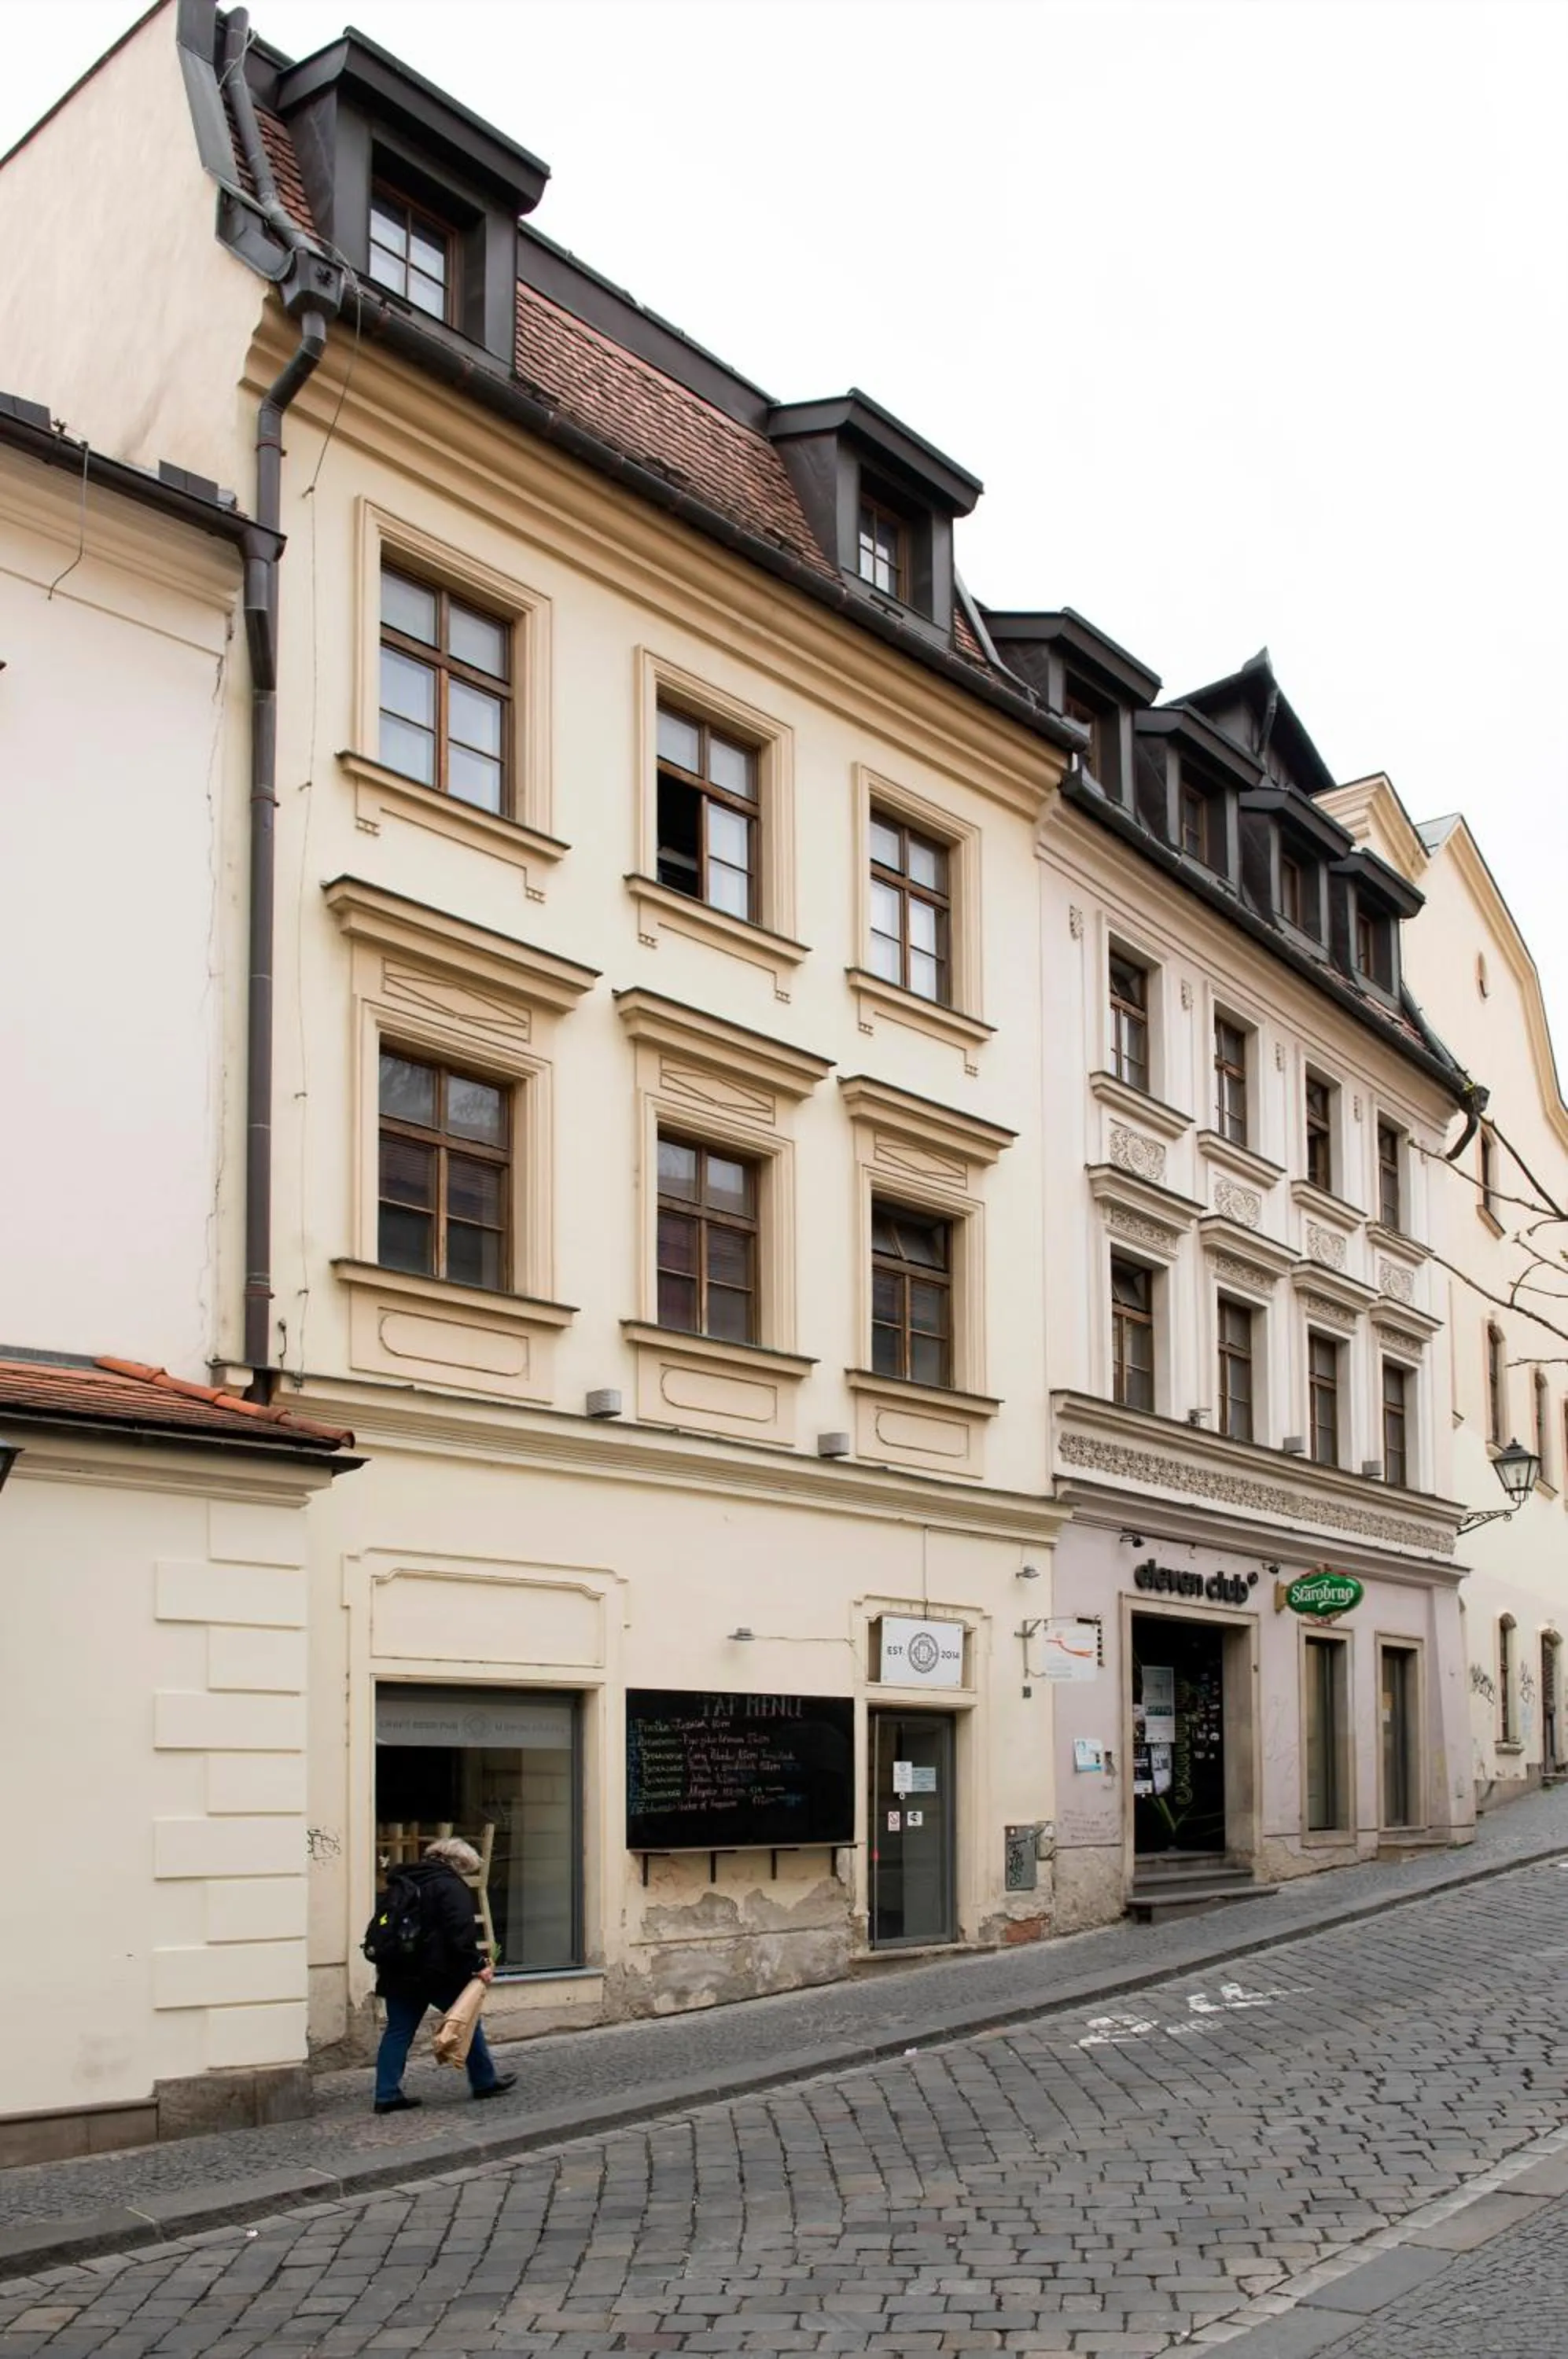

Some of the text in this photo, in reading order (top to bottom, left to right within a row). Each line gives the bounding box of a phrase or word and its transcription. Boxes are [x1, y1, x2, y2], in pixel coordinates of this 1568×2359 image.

[1134, 1559, 1249, 1604] eleven club
[1291, 1581, 1354, 1610] Starobrno
